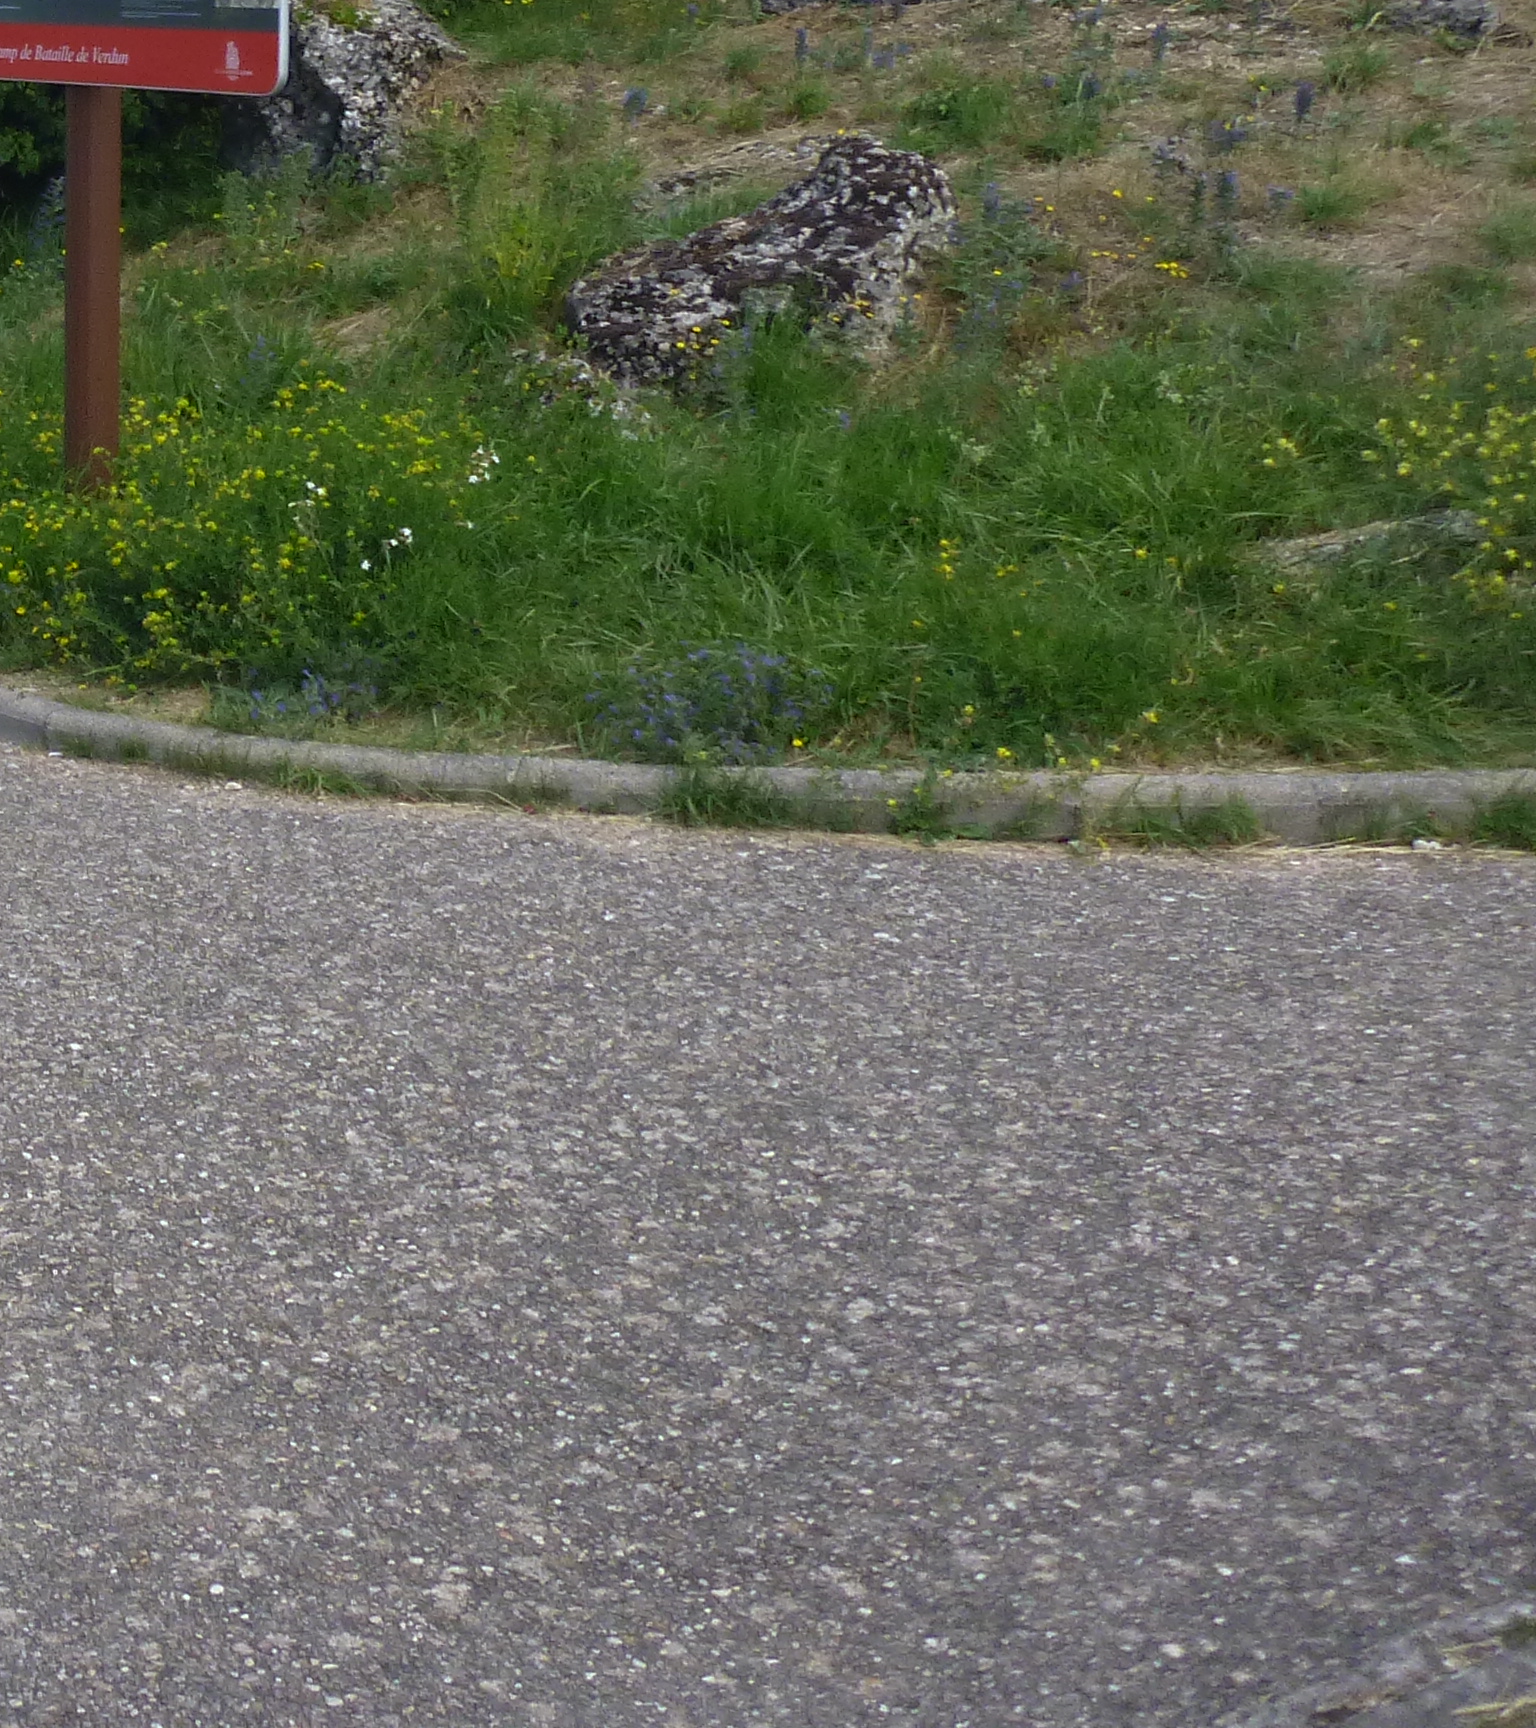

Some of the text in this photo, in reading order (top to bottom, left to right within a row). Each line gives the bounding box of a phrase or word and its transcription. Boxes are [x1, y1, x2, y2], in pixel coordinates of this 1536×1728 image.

[20, 43, 33, 61] de
[34, 44, 75, 62] Bataille
[76, 46, 89, 63] de
[92, 47, 129, 65] Verdun
